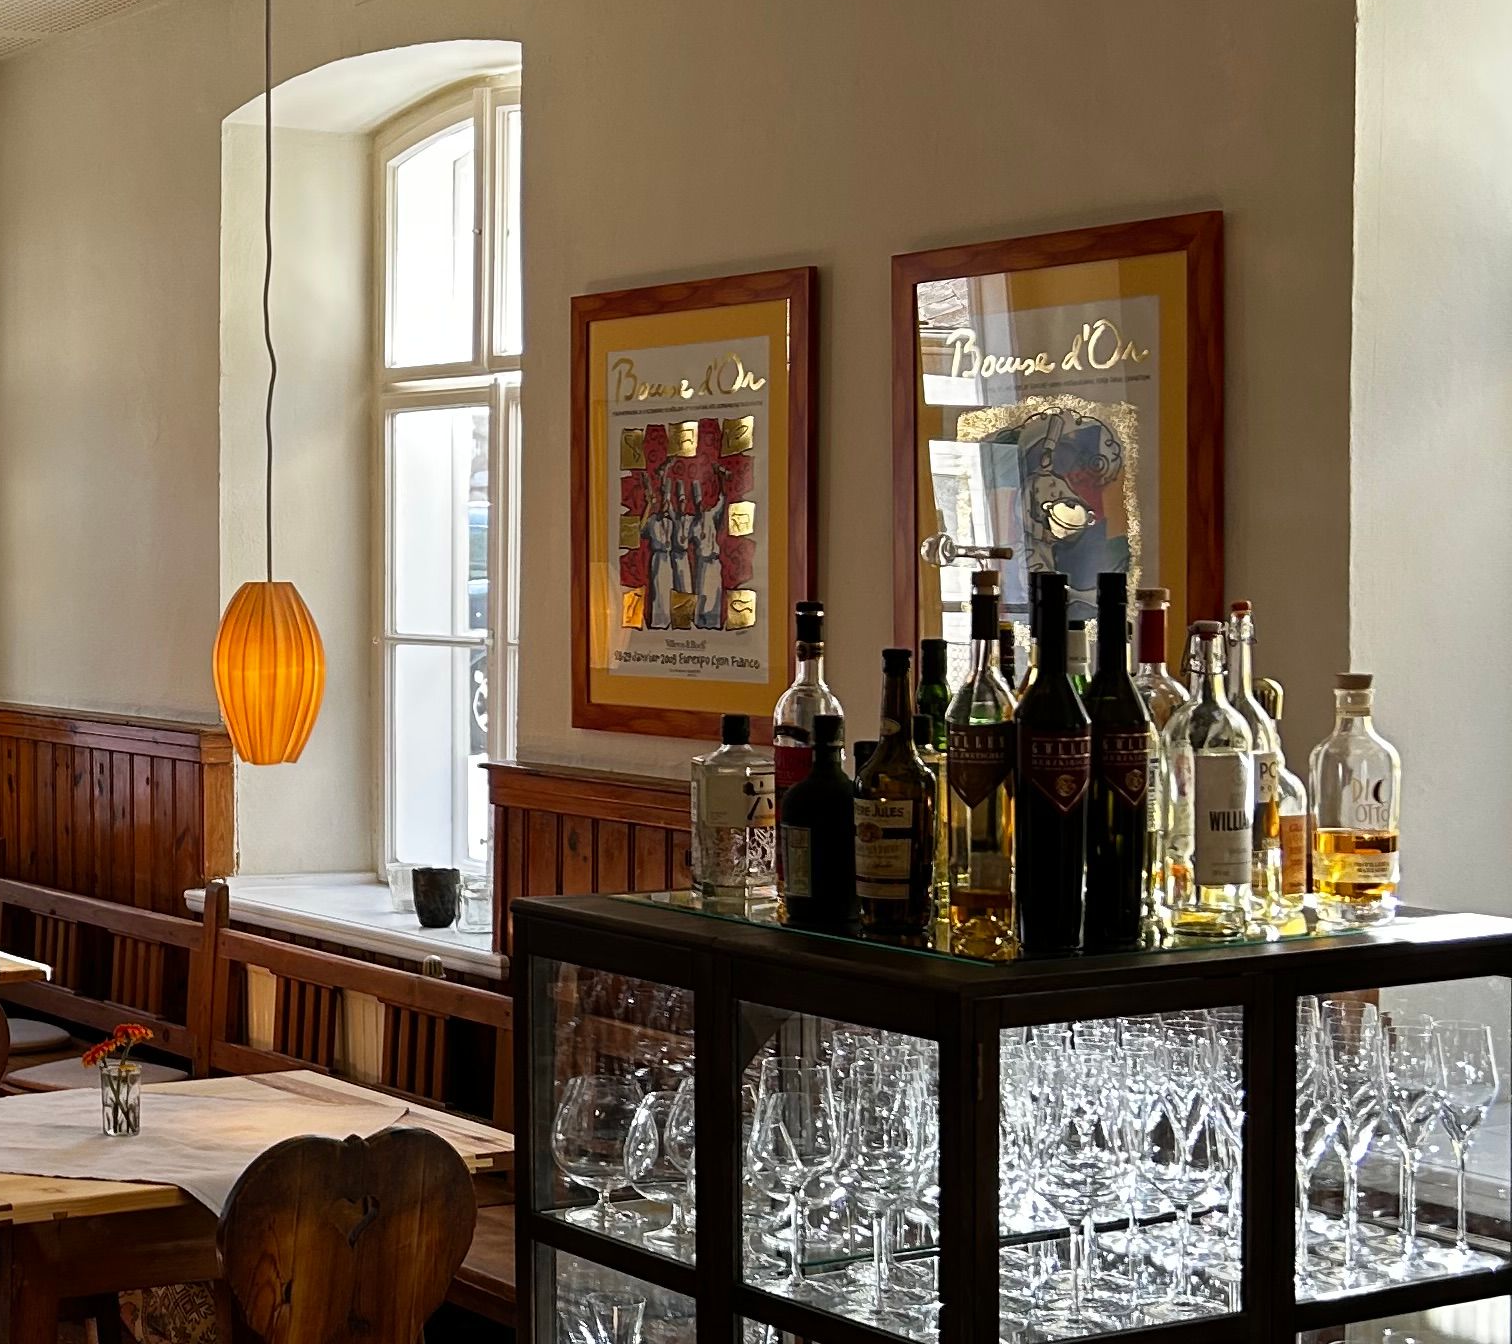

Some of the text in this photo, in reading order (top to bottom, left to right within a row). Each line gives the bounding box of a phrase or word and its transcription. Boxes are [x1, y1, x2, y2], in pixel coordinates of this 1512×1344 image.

[945, 318, 1151, 379] Bocuse d'Or
[698, 351, 767, 396] d'Or
[871, 803, 905, 818] JULES
